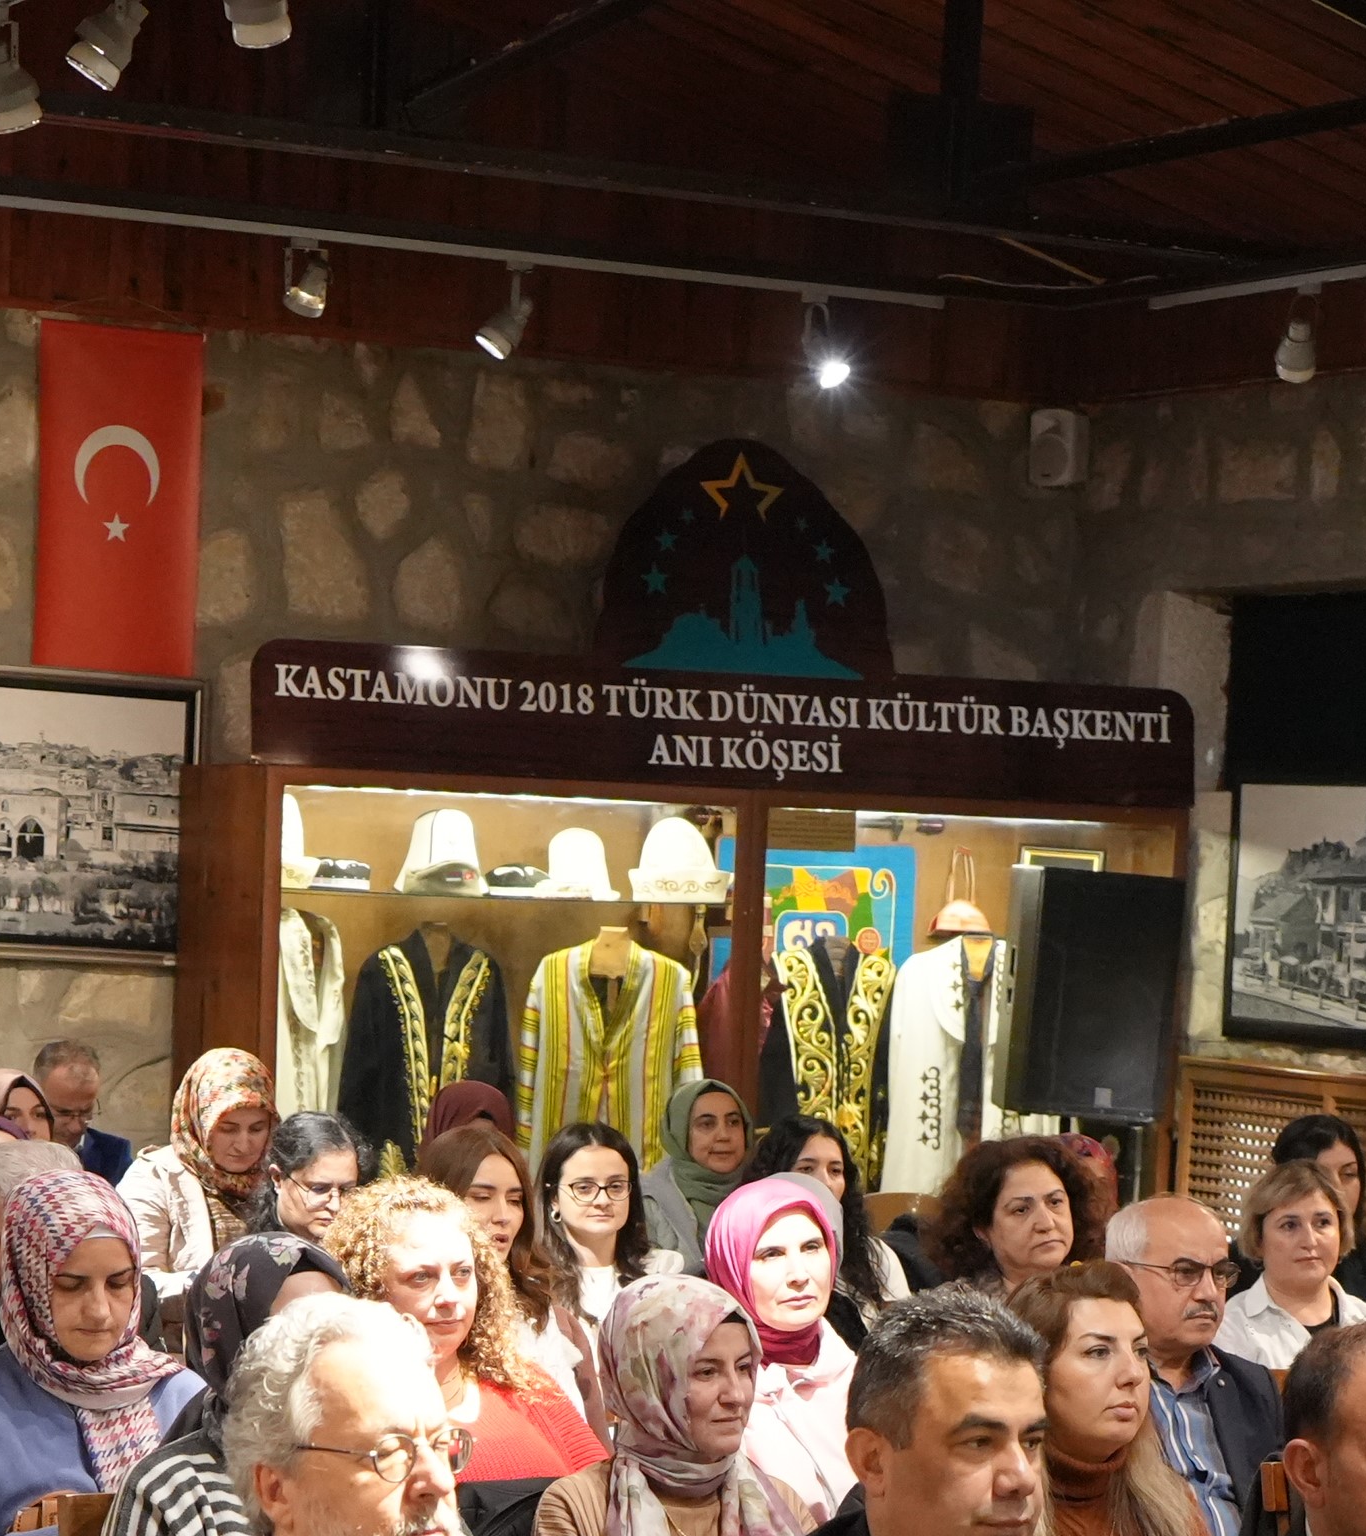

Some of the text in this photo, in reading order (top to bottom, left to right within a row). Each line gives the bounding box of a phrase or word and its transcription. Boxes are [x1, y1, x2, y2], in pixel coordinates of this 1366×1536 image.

[274, 663, 1172, 750] KASTAMONU 2018 TÜRK DÜNYASI KÜLTÜR BAŞKENTİ
[647, 729, 843, 782] ANI KÖŞESİ
